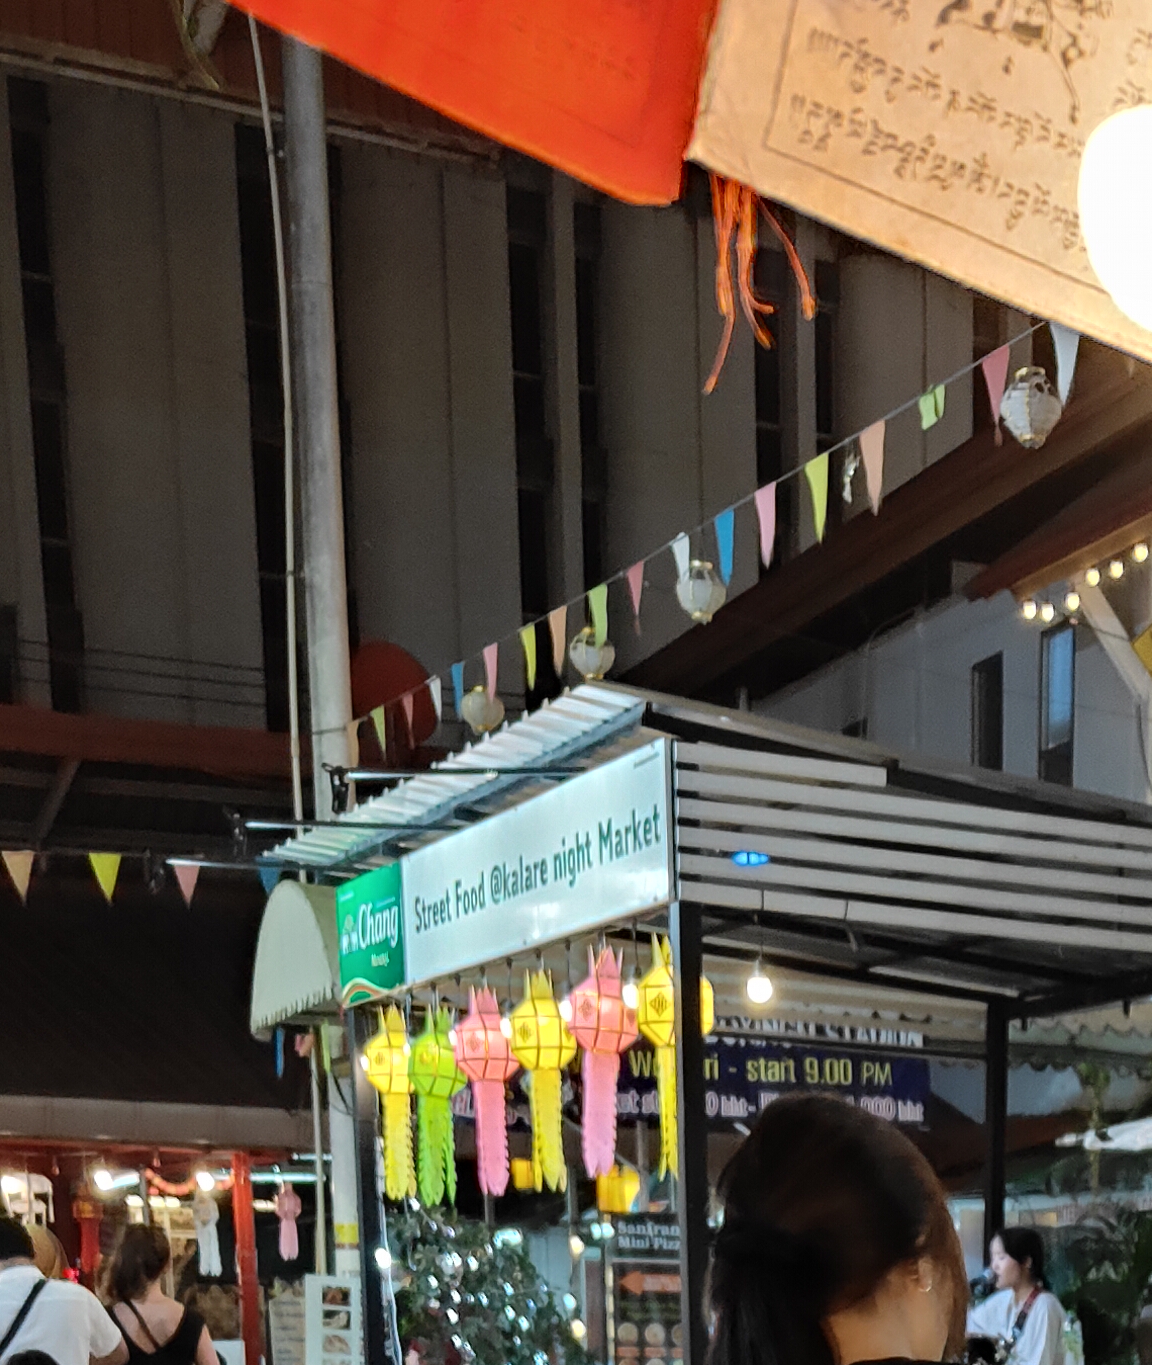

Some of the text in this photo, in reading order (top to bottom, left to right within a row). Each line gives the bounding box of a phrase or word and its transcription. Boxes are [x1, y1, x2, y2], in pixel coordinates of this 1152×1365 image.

[414, 804, 662, 933] Street Food @kalare night Market
[358, 900, 399, 950] Chang
[746, 1057, 797, 1084] start
[803, 1056, 853, 1085] 9.00
[861, 1061, 893, 1087] PM
